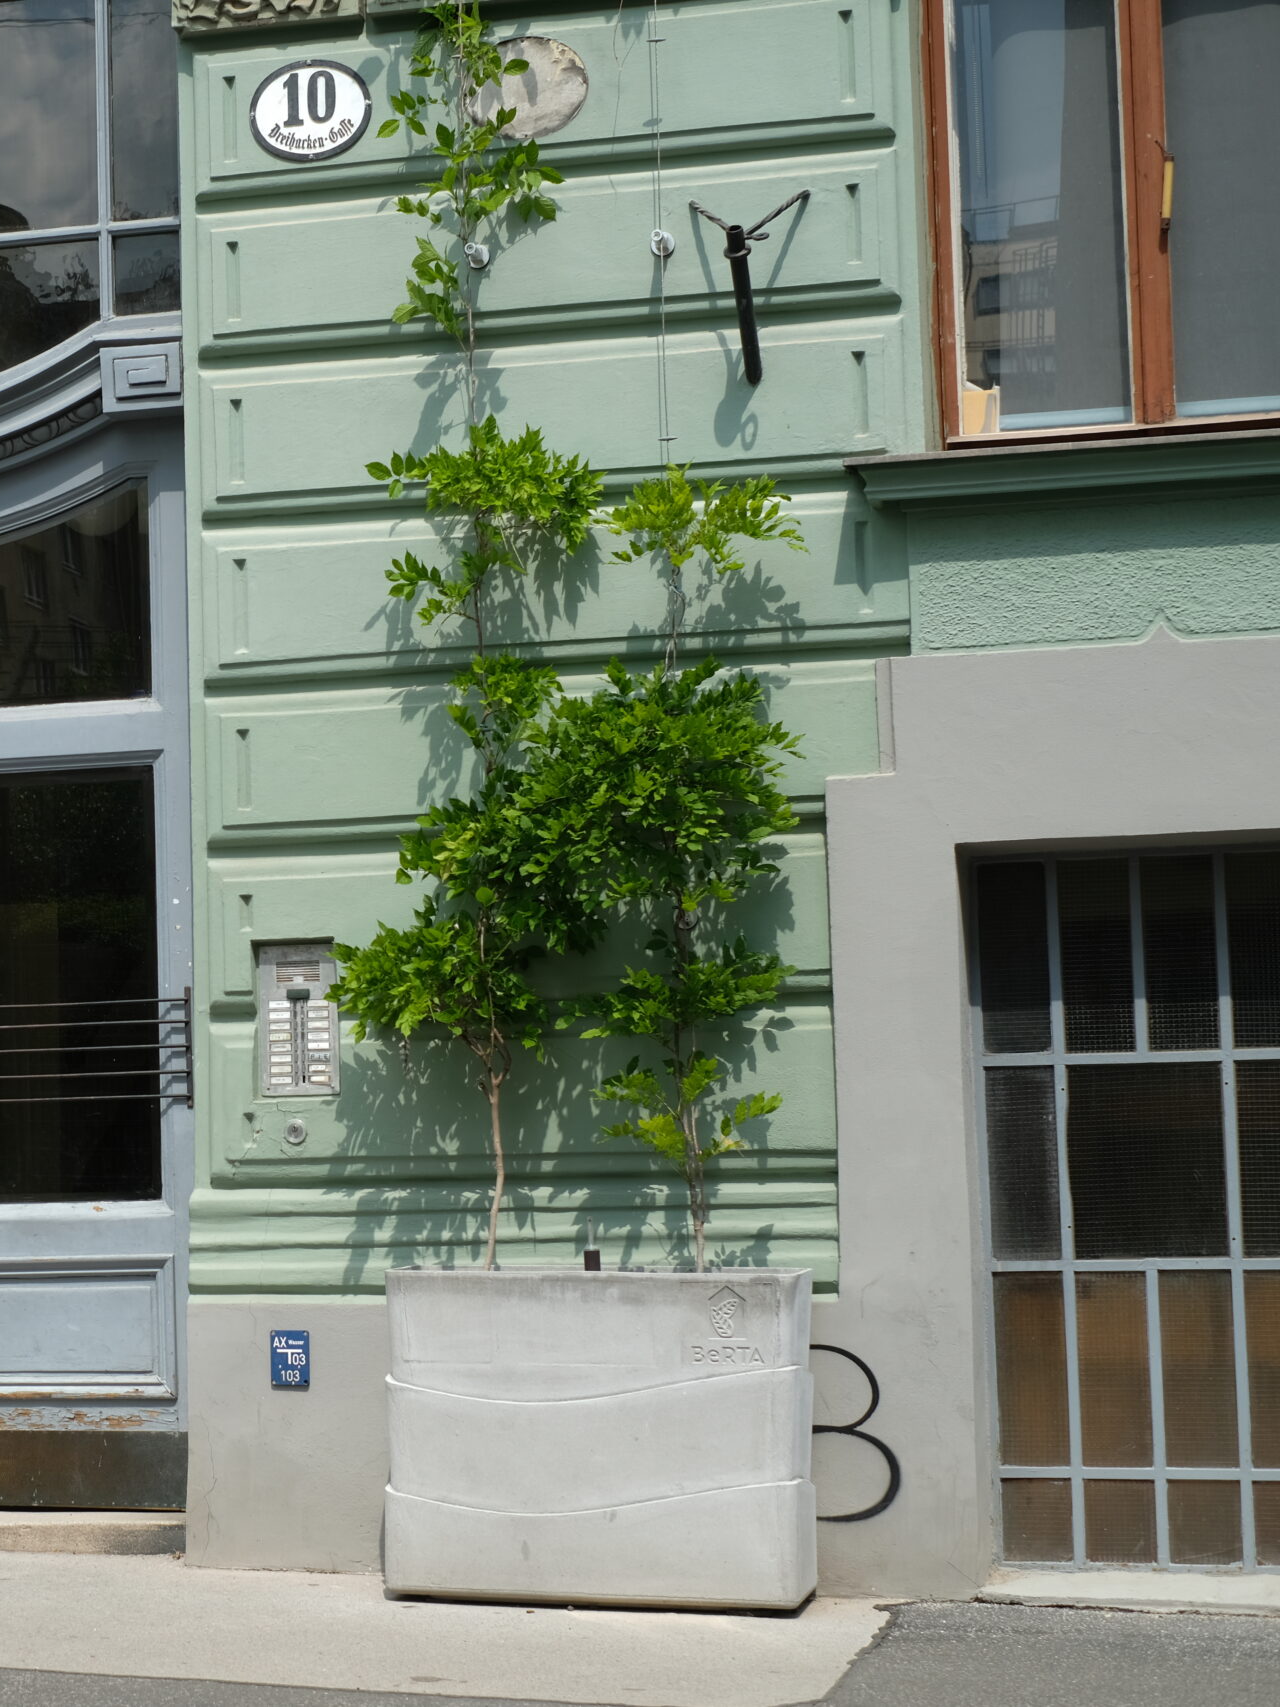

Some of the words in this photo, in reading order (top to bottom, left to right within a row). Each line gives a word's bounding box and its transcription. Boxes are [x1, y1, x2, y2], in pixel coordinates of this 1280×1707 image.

[282, 70, 336, 128] 10
[273, 1336, 287, 1348] AX
[690, 1345, 765, 1365] BeRTA
